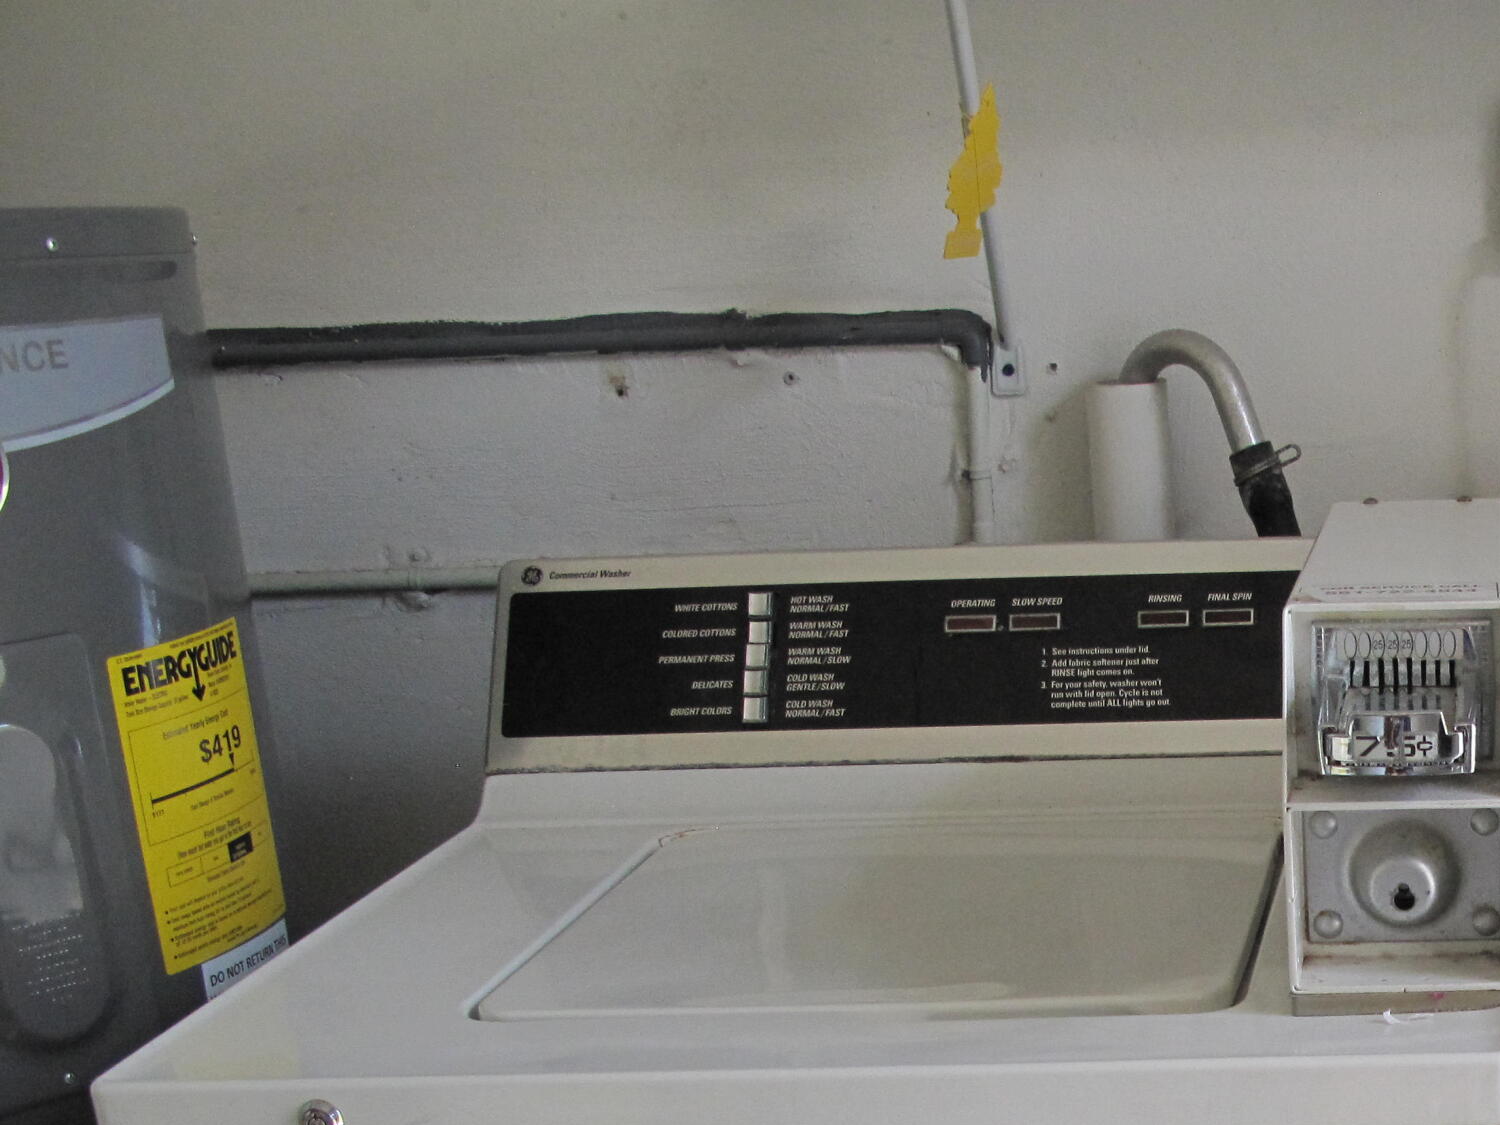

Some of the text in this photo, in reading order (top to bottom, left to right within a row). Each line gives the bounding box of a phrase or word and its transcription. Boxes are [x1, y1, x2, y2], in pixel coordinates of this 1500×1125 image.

[549, 570, 631, 580] Commercial Washer
[790, 595, 834, 604] HOT WASH
[1148, 594, 1183, 603] RINSING
[1208, 592, 1253, 601] FINAL SPIN
[674, 602, 739, 612] WHITE COTTONS
[951, 599, 996, 608] OPERATING
[1012, 597, 1063, 607] SLOW SPEED
[789, 620, 844, 630] WARM WASH
[662, 628, 737, 639] COLORED COTTONS
[788, 647, 842, 656] WARM WASH
[1068, 646, 1113, 655] instructions
[1114, 646, 1136, 654] under
[658, 654, 736, 664] PERMANENT PRESS
[1051, 659, 1067, 667] Add
[1068, 659, 1091, 667] fabric
[1092, 659, 1123, 667] softener
[1124, 658, 1140, 667] just
[786, 673, 834, 682] COLD WASH
[1051, 668, 1076, 677] RINSE
[1077, 668, 1095, 678] light
[691, 680, 734, 689] DELICATES
[1051, 681, 1064, 689] For
[1065, 681, 1082, 690] your
[1110, 678, 1139, 687] washer
[1140, 677, 1162, 686] won't
[1065, 690, 1083, 698] with
[1084, 690, 1095, 698] lid
[1118, 688, 1141, 698] Cycle
[1142, 688, 1149, 696] is
[785, 699, 834, 708] COLD WASH
[1051, 700, 1087, 709] complete
[1106, 699, 1121, 707] ALL
[1123, 698, 1144, 708] lights
[1145, 699, 1156, 707] go
[670, 706, 733, 717] BRIGHT COLORS
[199, 725, 241, 763] $419
[209, 934, 287, 987] DO NOT RETURN THIS
